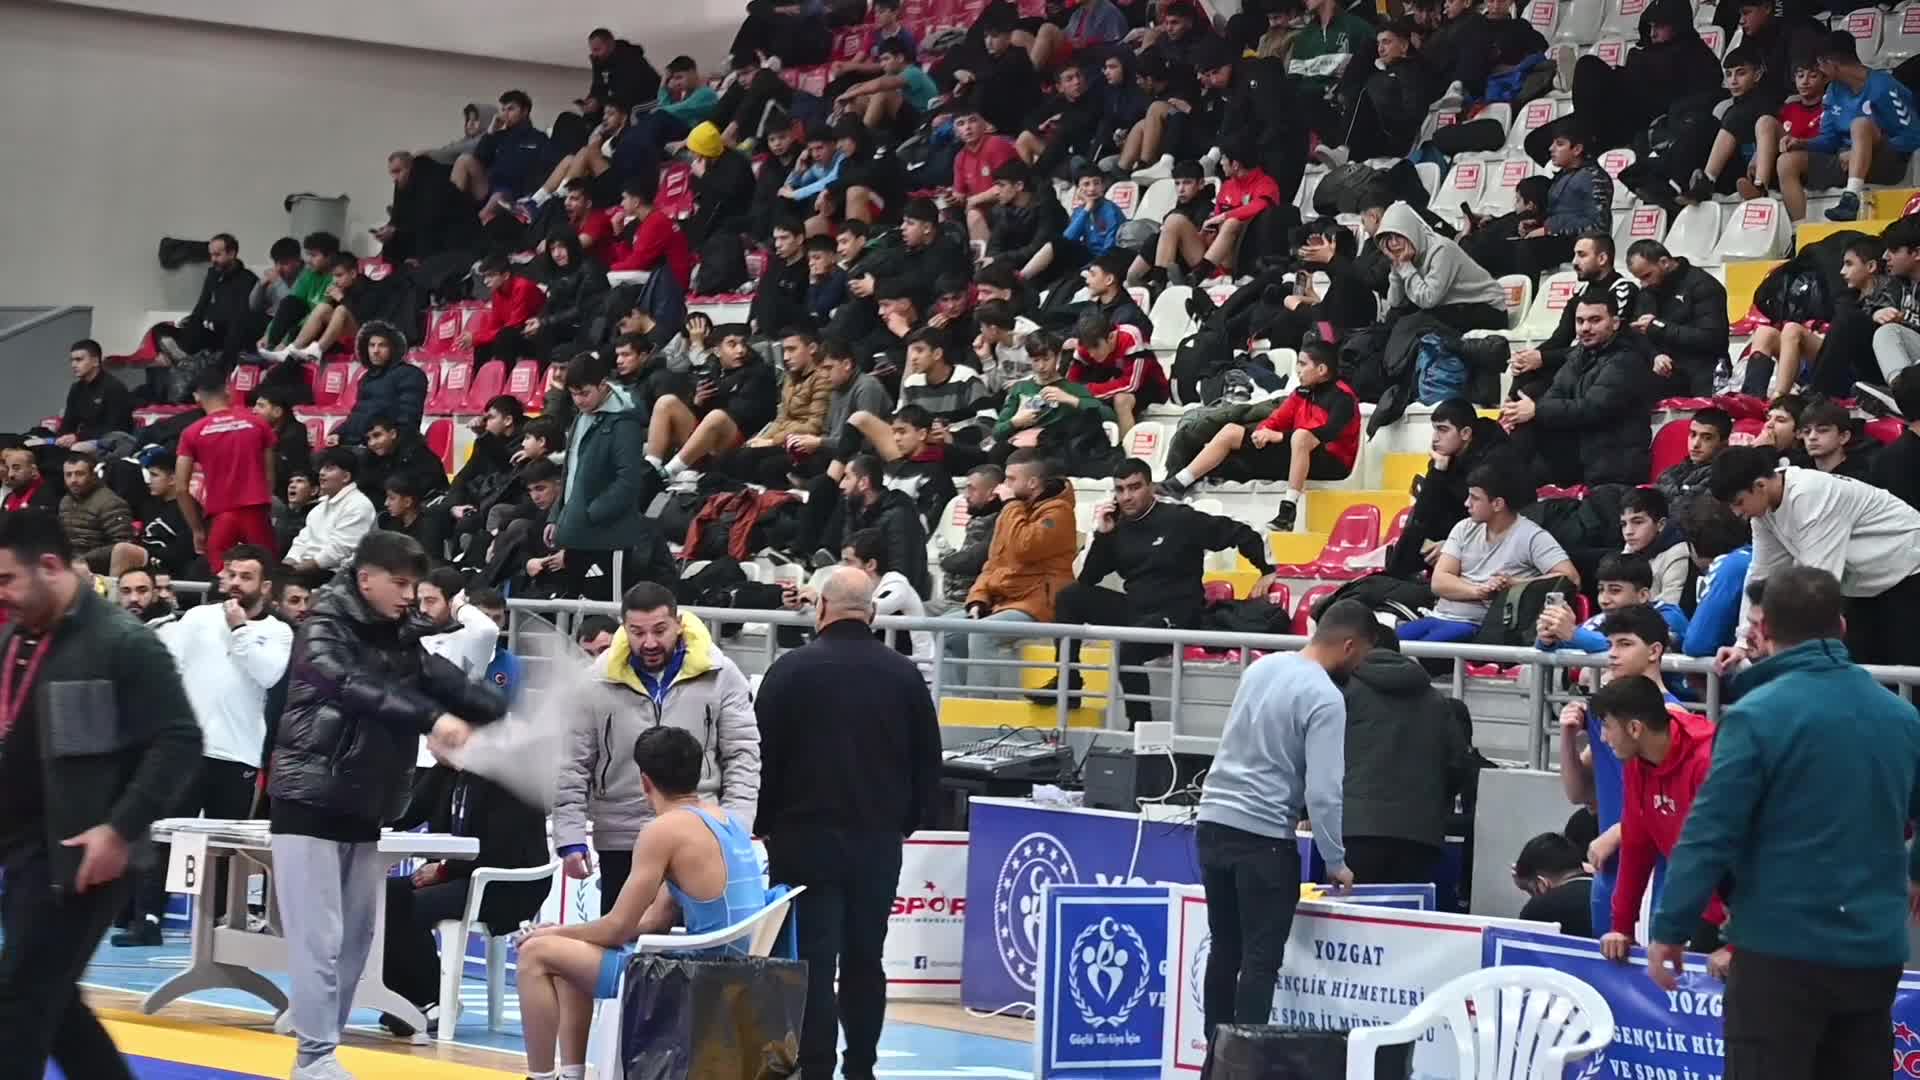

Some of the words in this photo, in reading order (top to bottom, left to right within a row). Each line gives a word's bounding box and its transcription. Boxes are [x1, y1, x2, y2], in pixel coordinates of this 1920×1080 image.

[185, 854, 196, 888] B
[888, 896, 966, 915] SPOR
[1314, 939, 1385, 966] YOZGAT
[1275, 974, 1328, 998] ENÇLİK
[1331, 977, 1425, 1008] HİZMETLERİ
[1666, 989, 1724, 1017] YOZG
[1282, 1007, 1320, 1034] SPOR
[1609, 1058, 1632, 1079] VE
